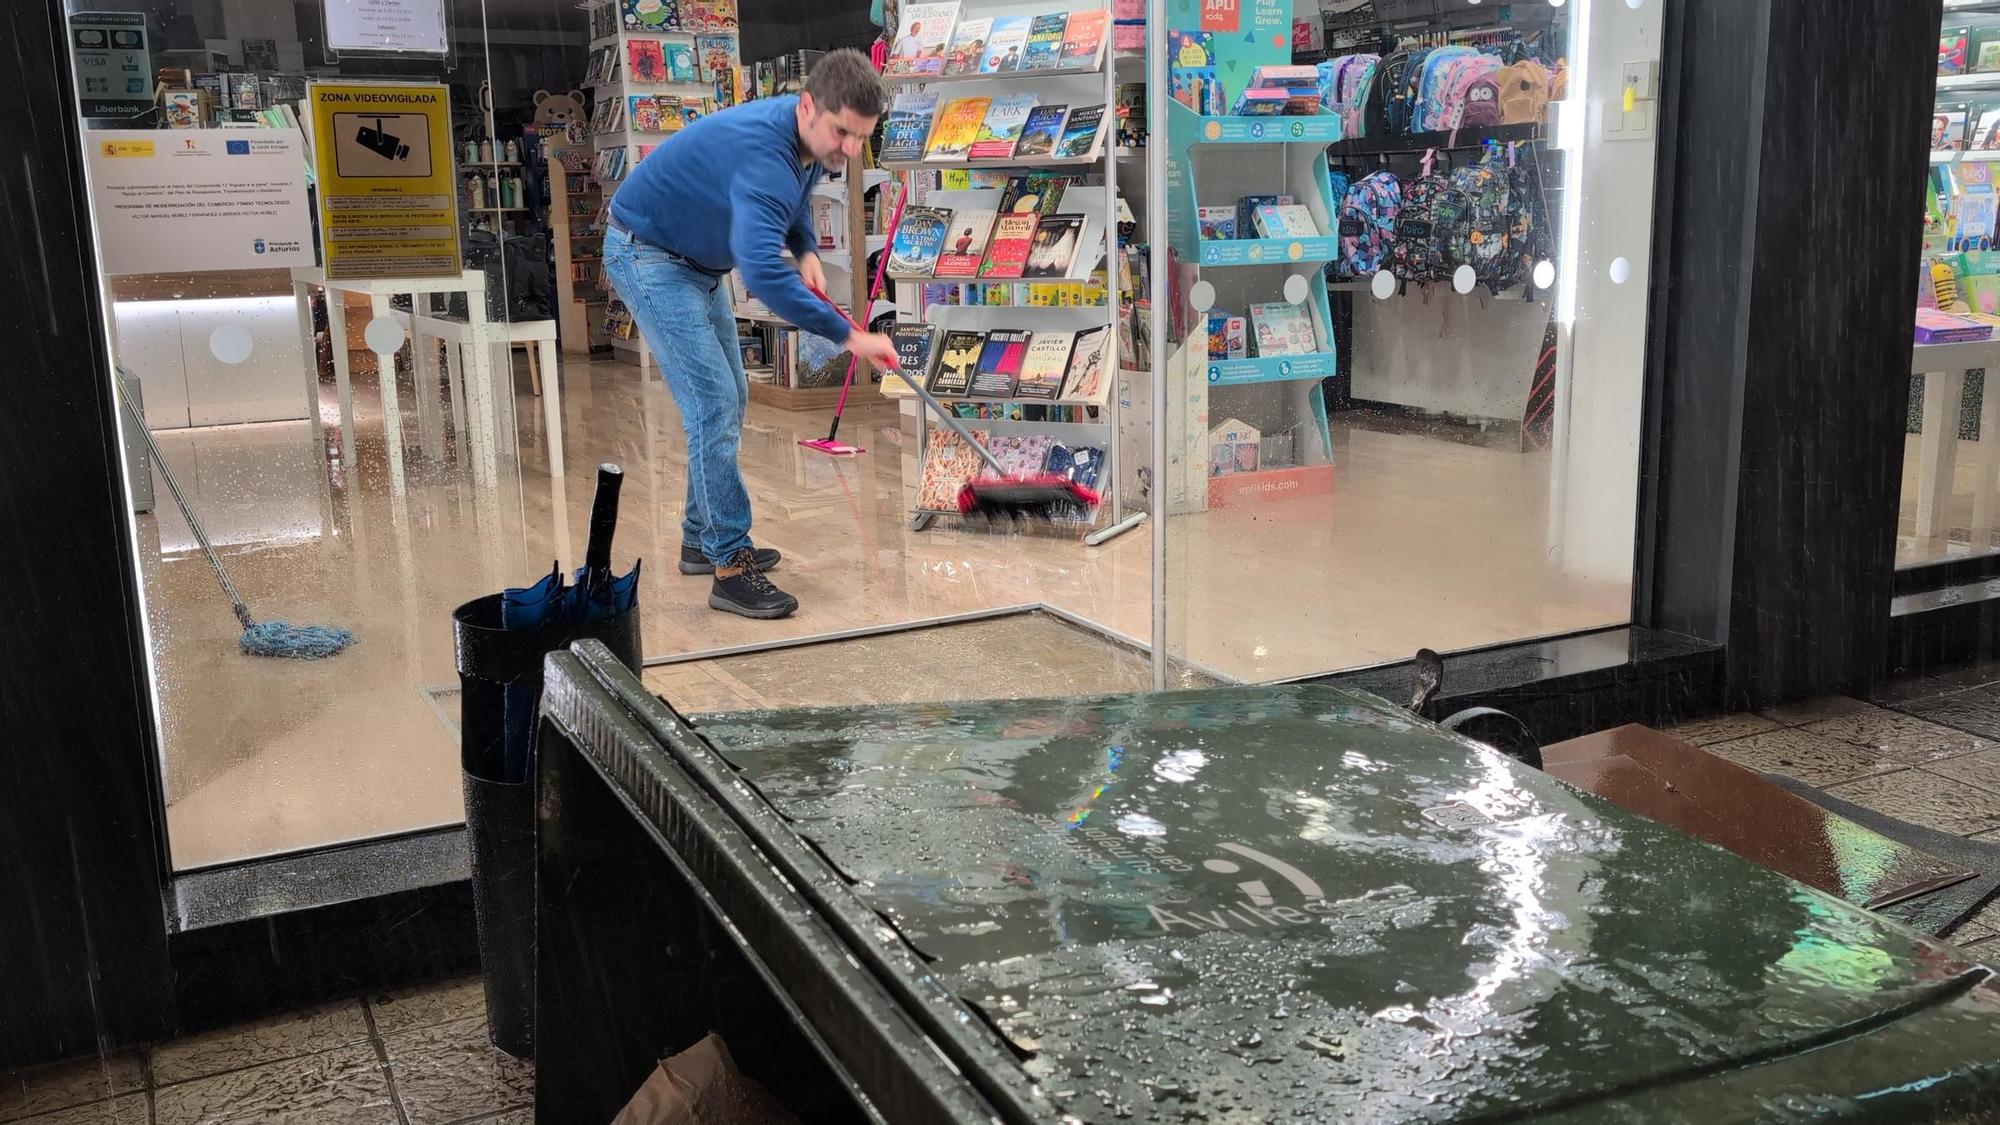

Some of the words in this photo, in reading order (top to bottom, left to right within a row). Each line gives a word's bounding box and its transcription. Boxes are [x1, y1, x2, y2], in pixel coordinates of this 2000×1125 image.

[1255, 7, 1283, 16] Learn
[1255, 17, 1282, 25] Grow.
[1028, 31, 1063, 42] SANATORIO
[83, 57, 107, 66] VISA
[320, 93, 351, 102] ZONA
[353, 94, 437, 103] VIDEOVIGILADA
[95, 105, 140, 113] Liberbank
[991, 106, 1023, 117] LARK
[905, 112, 917, 120] LA
[1071, 113, 1101, 122] SANTIAGO
[891, 120, 925, 131] CHICA
[896, 130, 915, 140] DEL
[914, 219, 935, 228] DAN
[901, 224, 942, 237] BROWN
[901, 343, 918, 352] LOS
[1079, 826, 1139, 859] mejor
[1125, 859, 1161, 876] su
